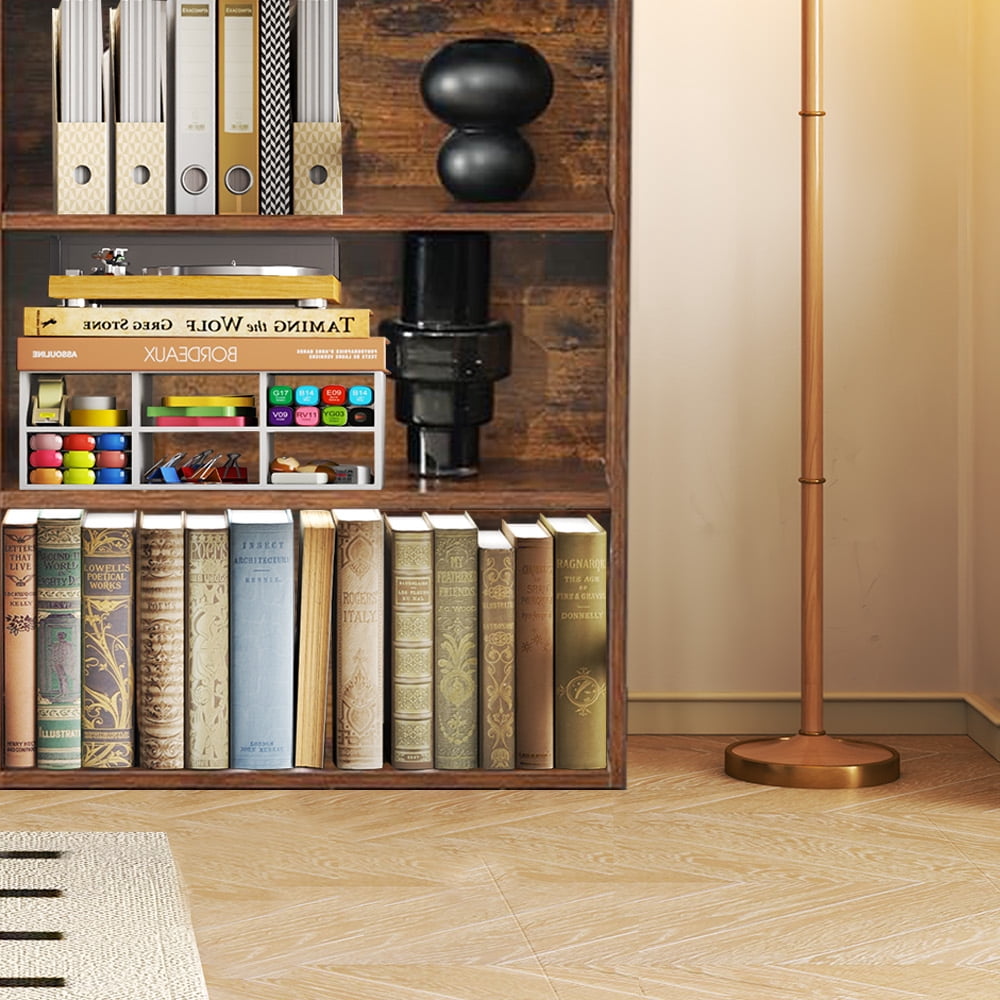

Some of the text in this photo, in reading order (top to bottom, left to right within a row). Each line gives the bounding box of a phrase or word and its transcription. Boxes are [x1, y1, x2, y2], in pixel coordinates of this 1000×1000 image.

[323, 410, 345, 418] YG03
[242, 541, 284, 549] INSECT
[87, 572, 127, 581] POETICAL
[563, 575, 582, 583] THE
[89, 582, 122, 592] WORKS
[342, 610, 377, 623] ITALY
[561, 611, 604, 620] DONNELLY
